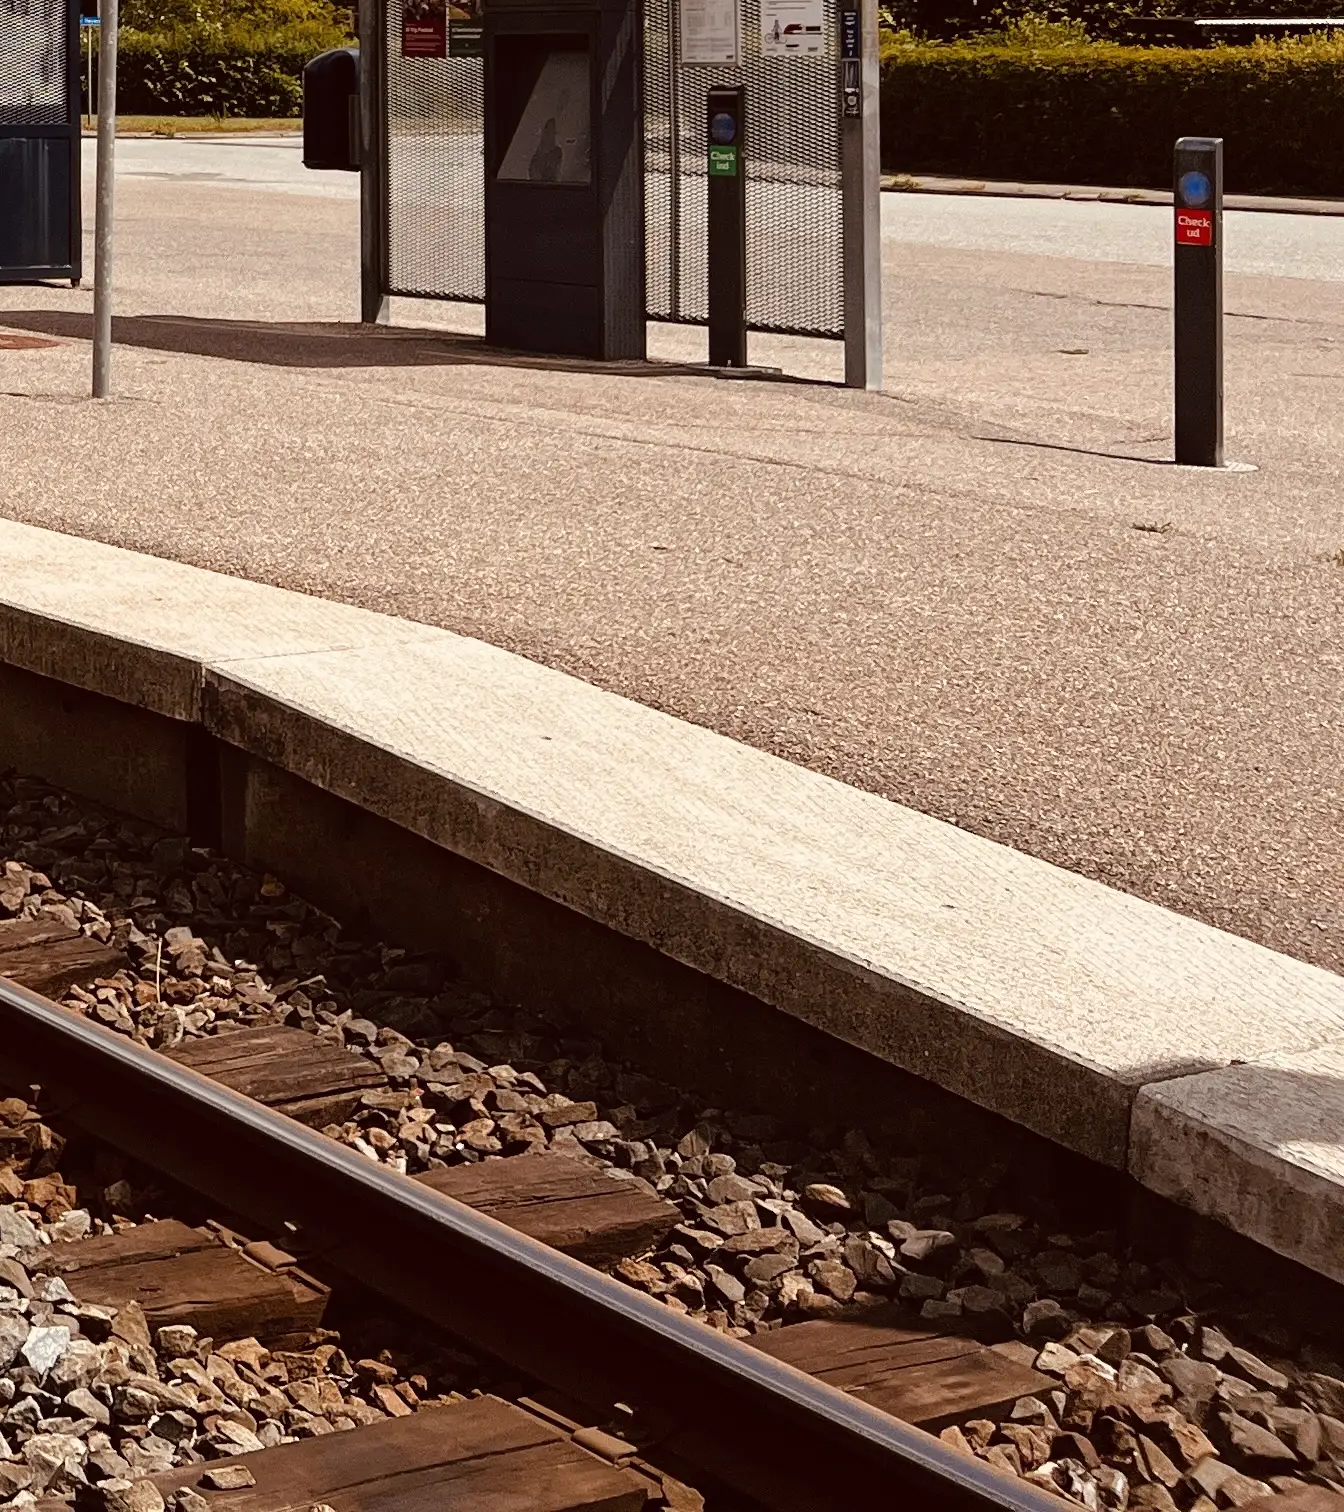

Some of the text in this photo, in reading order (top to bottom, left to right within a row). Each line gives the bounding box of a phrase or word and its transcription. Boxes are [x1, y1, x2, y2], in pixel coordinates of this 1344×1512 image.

[710, 151, 735, 160] Check
[1178, 216, 1211, 227] Check
[1187, 228, 1200, 237] ud
